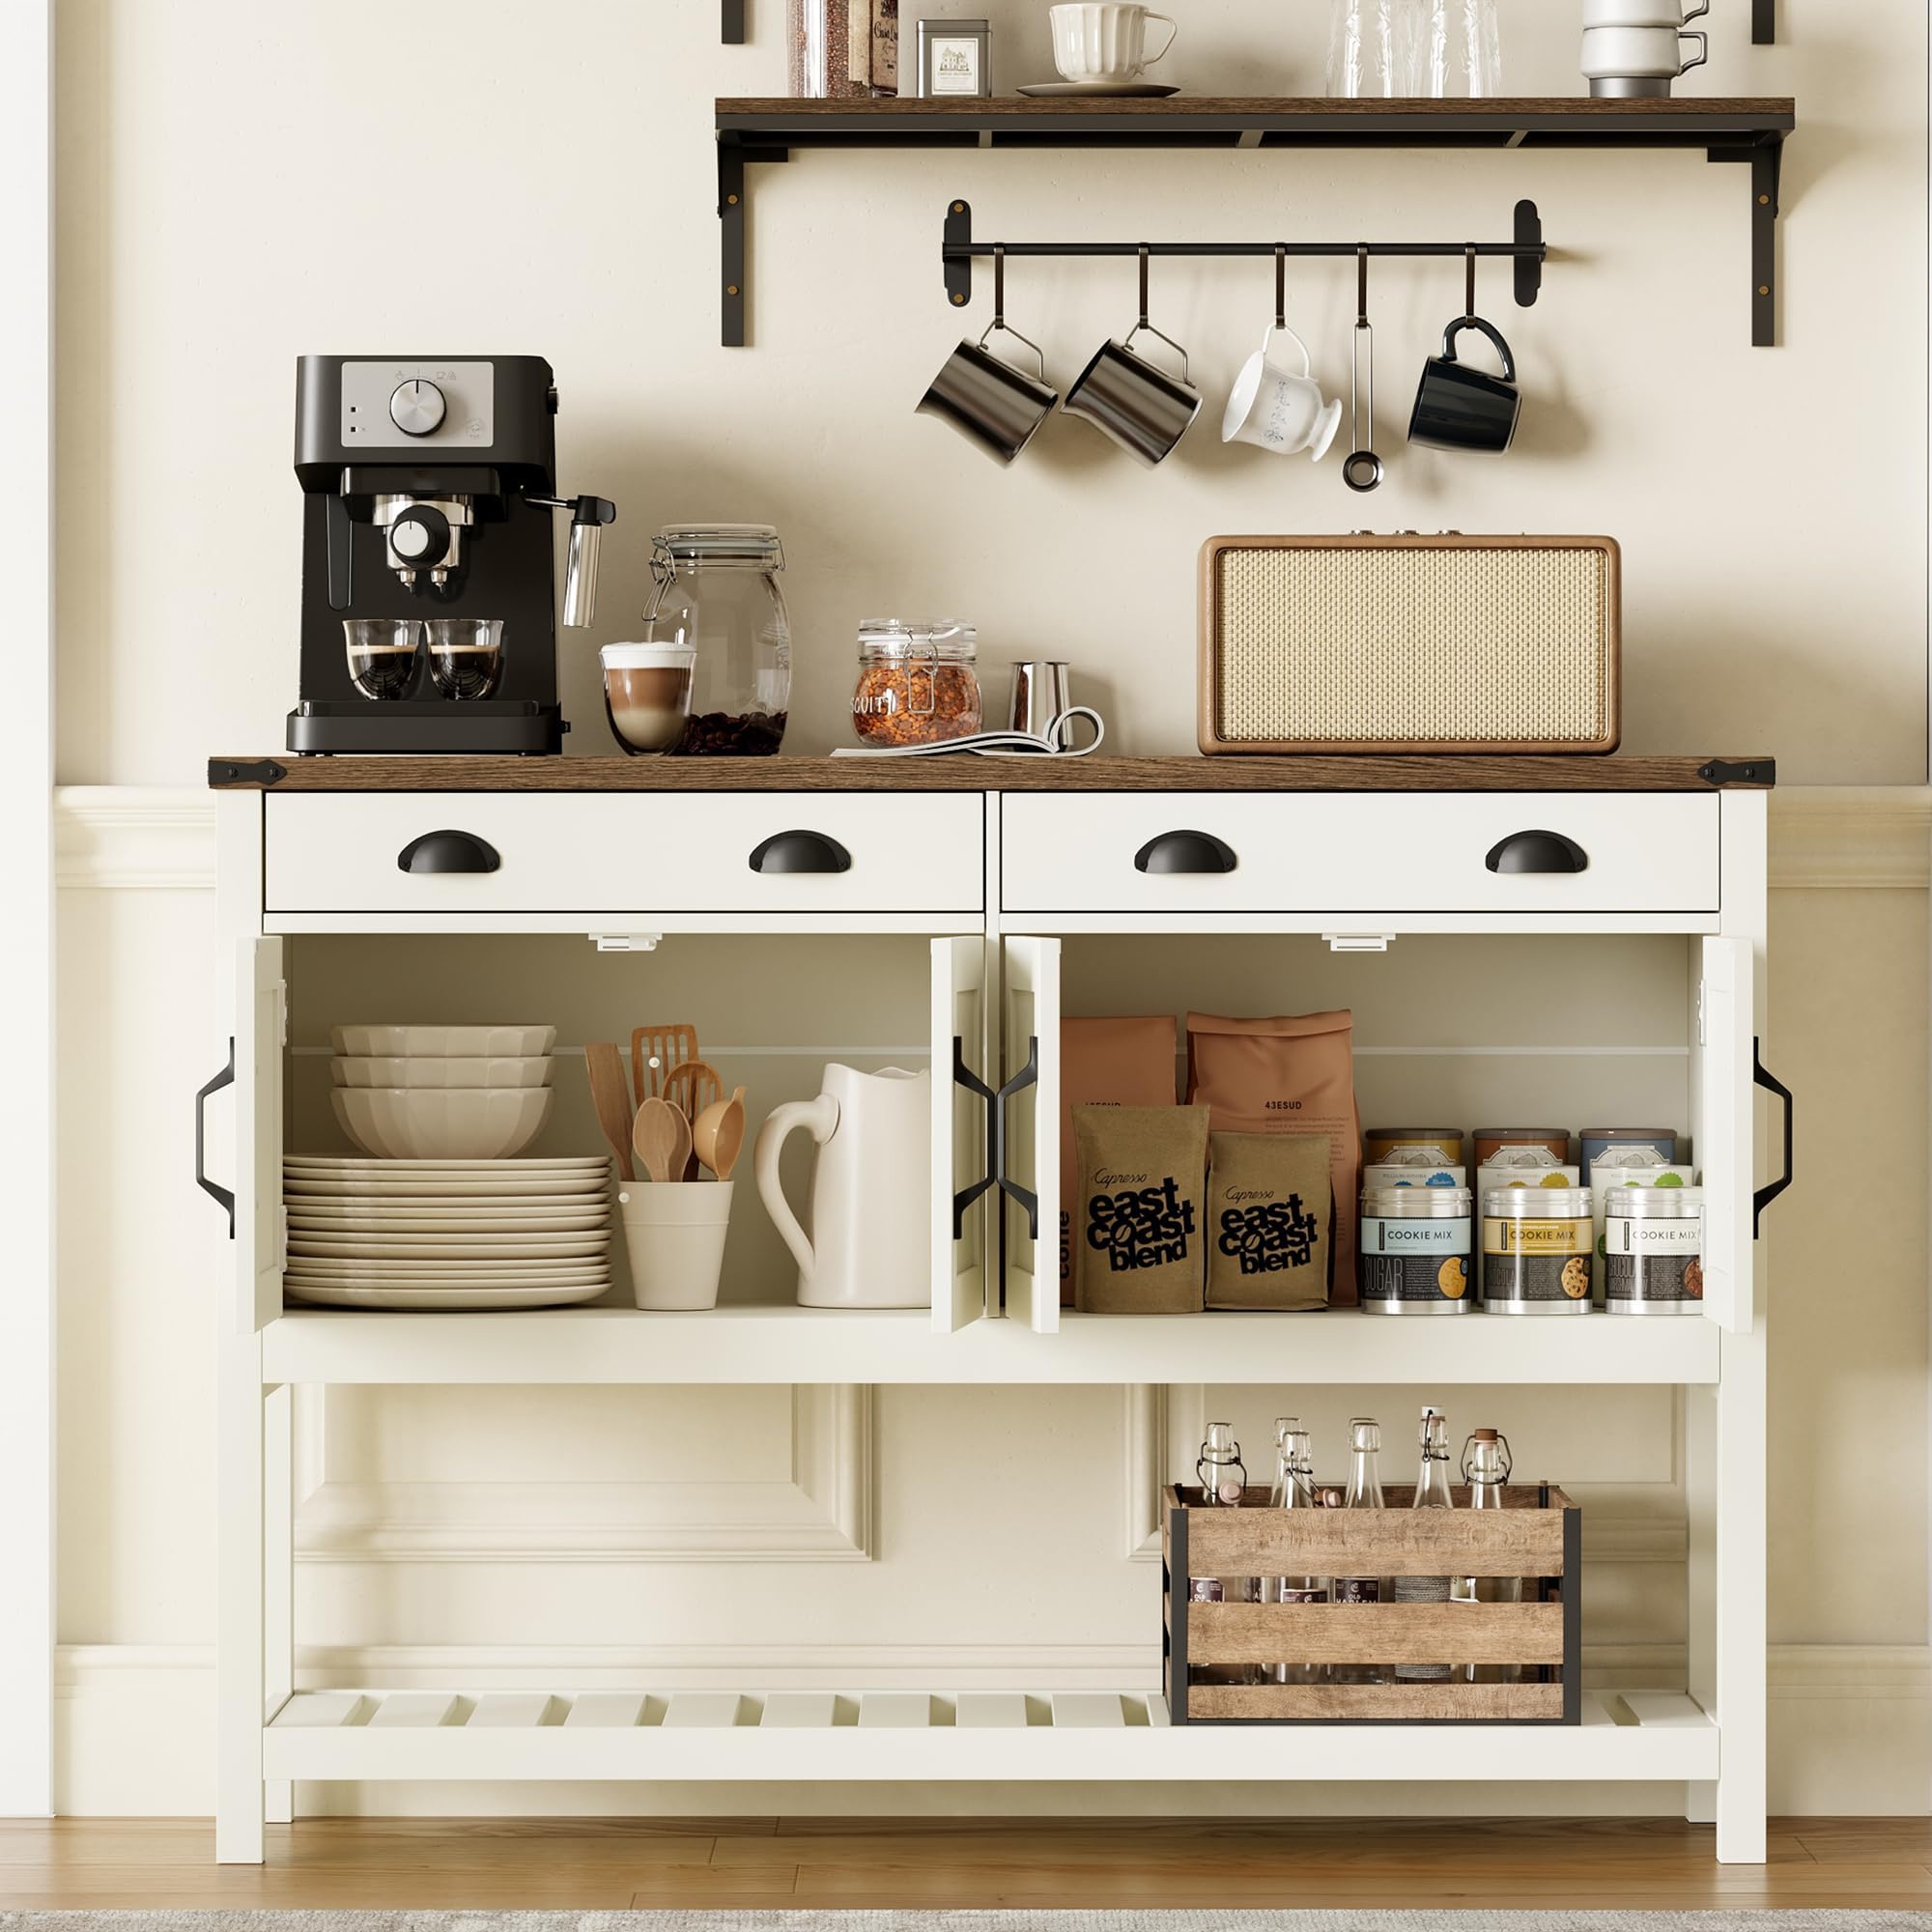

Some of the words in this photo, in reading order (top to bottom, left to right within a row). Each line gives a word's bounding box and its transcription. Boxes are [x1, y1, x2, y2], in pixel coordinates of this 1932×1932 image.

[1264, 1100, 1302, 1110] 43ESUD
[1091, 1167, 1147, 1189] Capresso
[1089, 1177, 1179, 1223] east
[1224, 1185, 1275, 1205] Capresso
[1087, 1199, 1196, 1250] coast
[1221, 1193, 1303, 1233] east
[1218, 1212, 1318, 1256] coast
[1387, 1231, 1431, 1239] COOKIE
[1434, 1231, 1452, 1239] MIX
[1510, 1231, 1552, 1239] COOKIE
[1556, 1231, 1575, 1239] MIX
[1633, 1231, 1675, 1239] COOKIE
[1679, 1231, 1697, 1239] MIX
[1109, 1235, 1187, 1272] blend
[1239, 1245, 1311, 1275] blend
[1364, 1257, 1404, 1292] SUGAR
